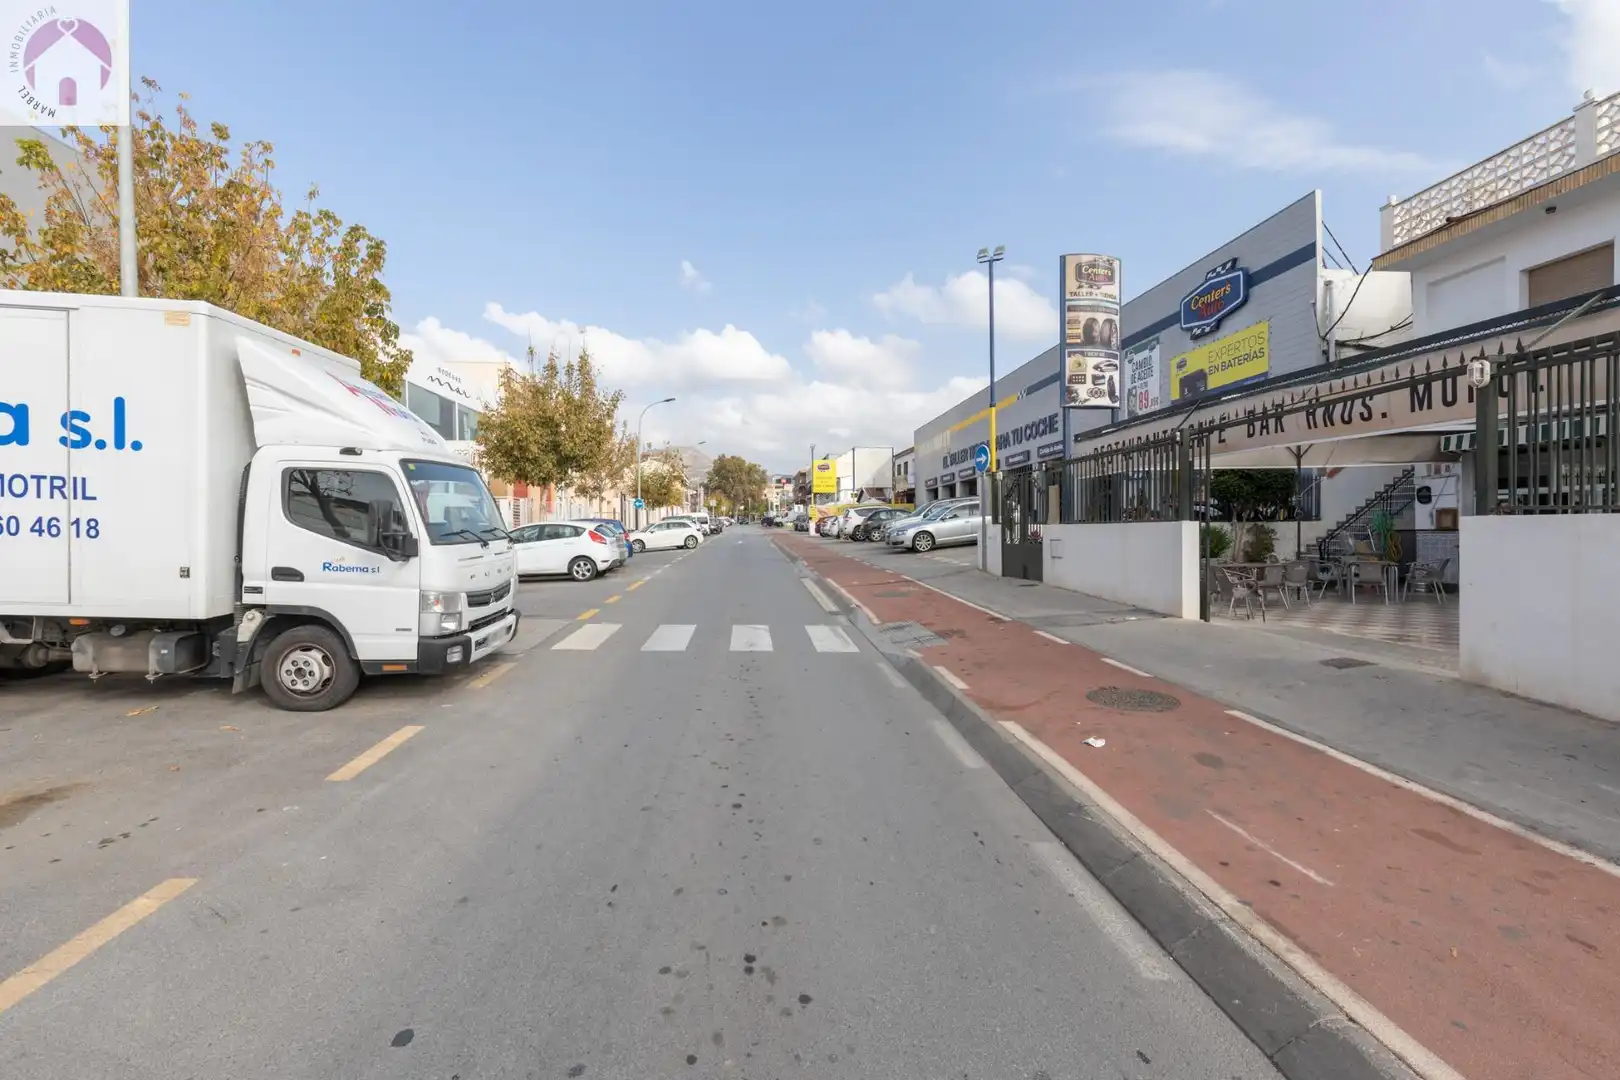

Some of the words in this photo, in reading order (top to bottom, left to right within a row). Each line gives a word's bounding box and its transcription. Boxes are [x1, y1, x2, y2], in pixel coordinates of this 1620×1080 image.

[1208, 331, 1266, 363] EXPERTOS
[1208, 365, 1220, 376] EN
[1221, 347, 1266, 372] BATERÍAS
[1132, 355, 1153, 373] CAMBIO
[59, 396, 143, 451] s.l.
[1010, 426, 1023, 446] TU
[1024, 412, 1059, 442] COCHE
[1247, 403, 1285, 438] BAR
[0, 473, 97, 501] OTRIL
[30, 516, 61, 538] 46
[70, 517, 100, 539] 18
